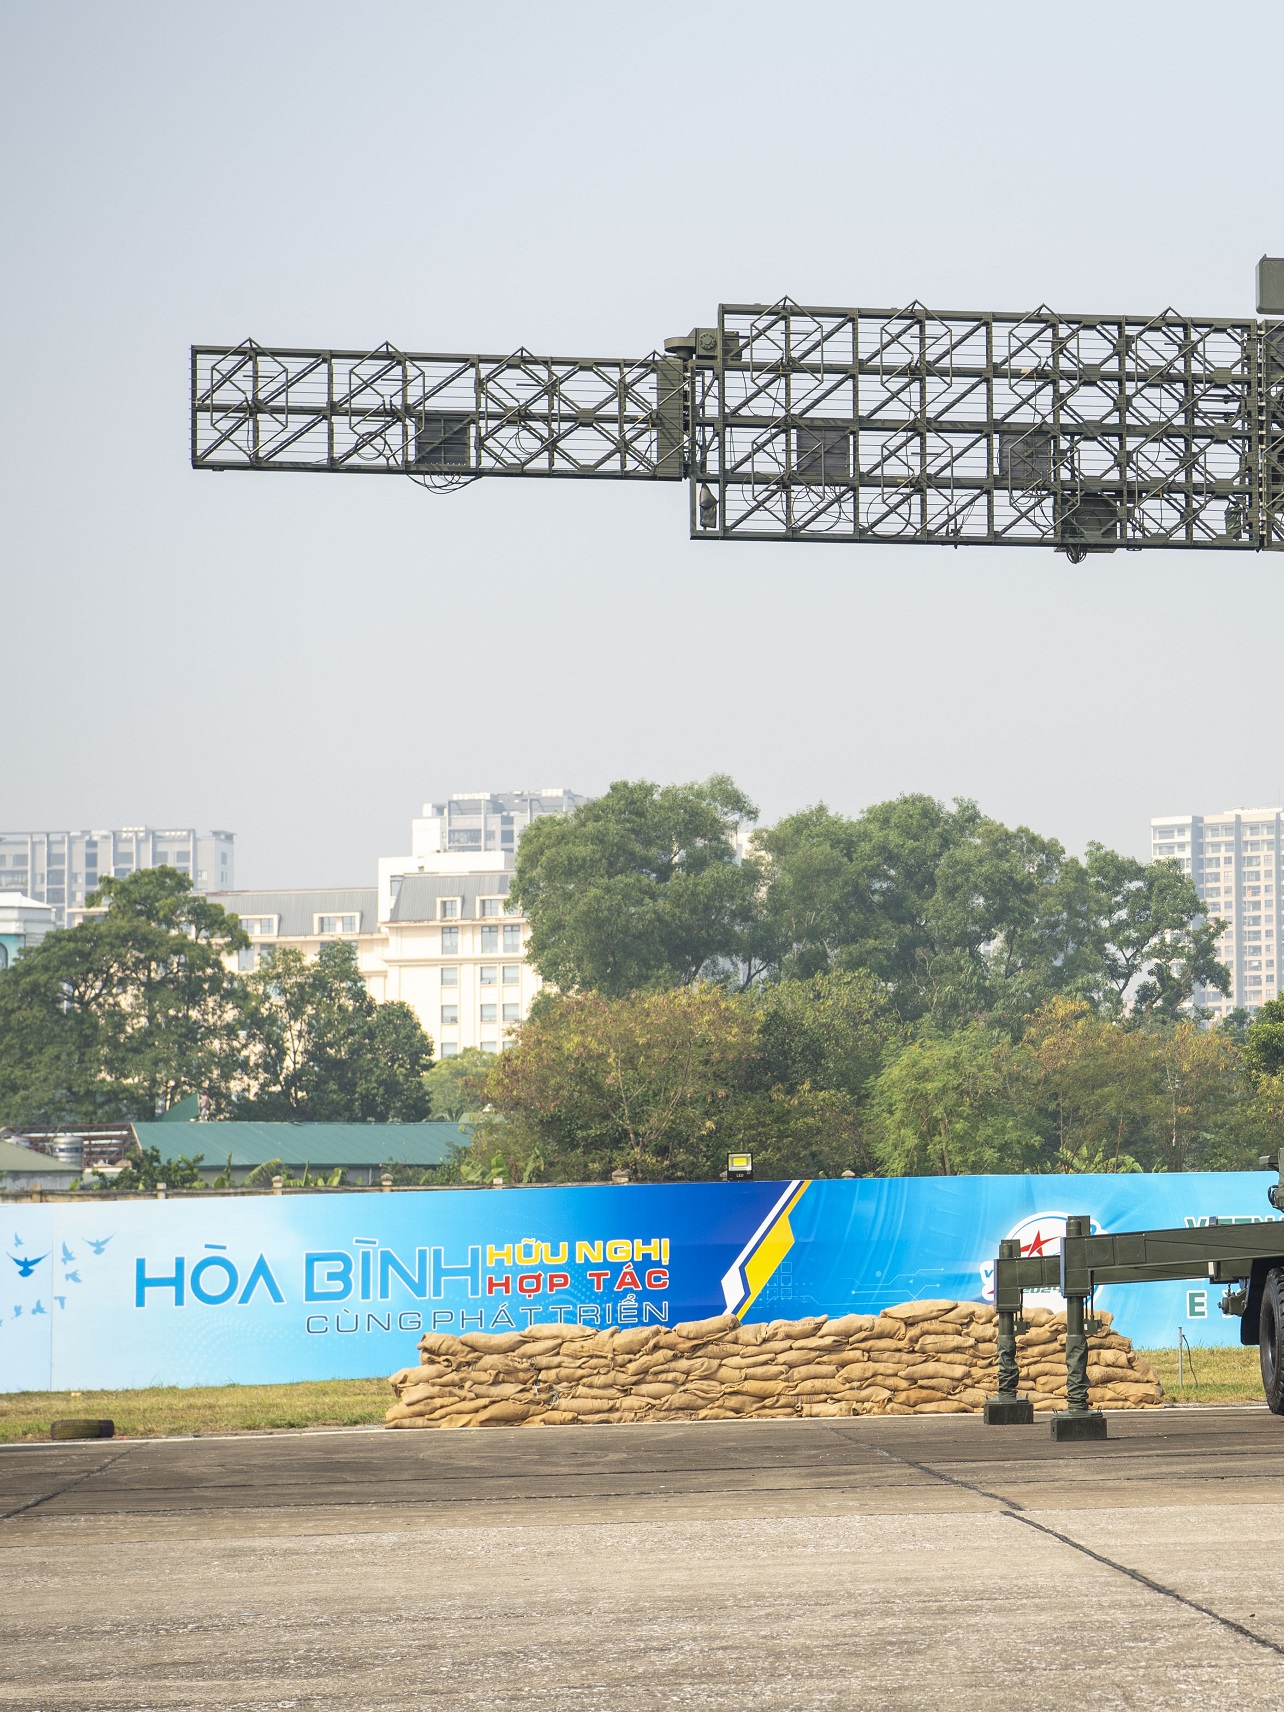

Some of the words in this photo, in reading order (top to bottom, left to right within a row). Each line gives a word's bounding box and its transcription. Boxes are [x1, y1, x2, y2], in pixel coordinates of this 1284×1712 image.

[487, 1238, 569, 1267] HỮU
[576, 1238, 670, 1265] NGHỊ
[136, 1243, 286, 1308] HÒA
[303, 1238, 482, 1303] BÌNH
[487, 1270, 570, 1298] HỢP
[588, 1263, 669, 1291] TÁC
